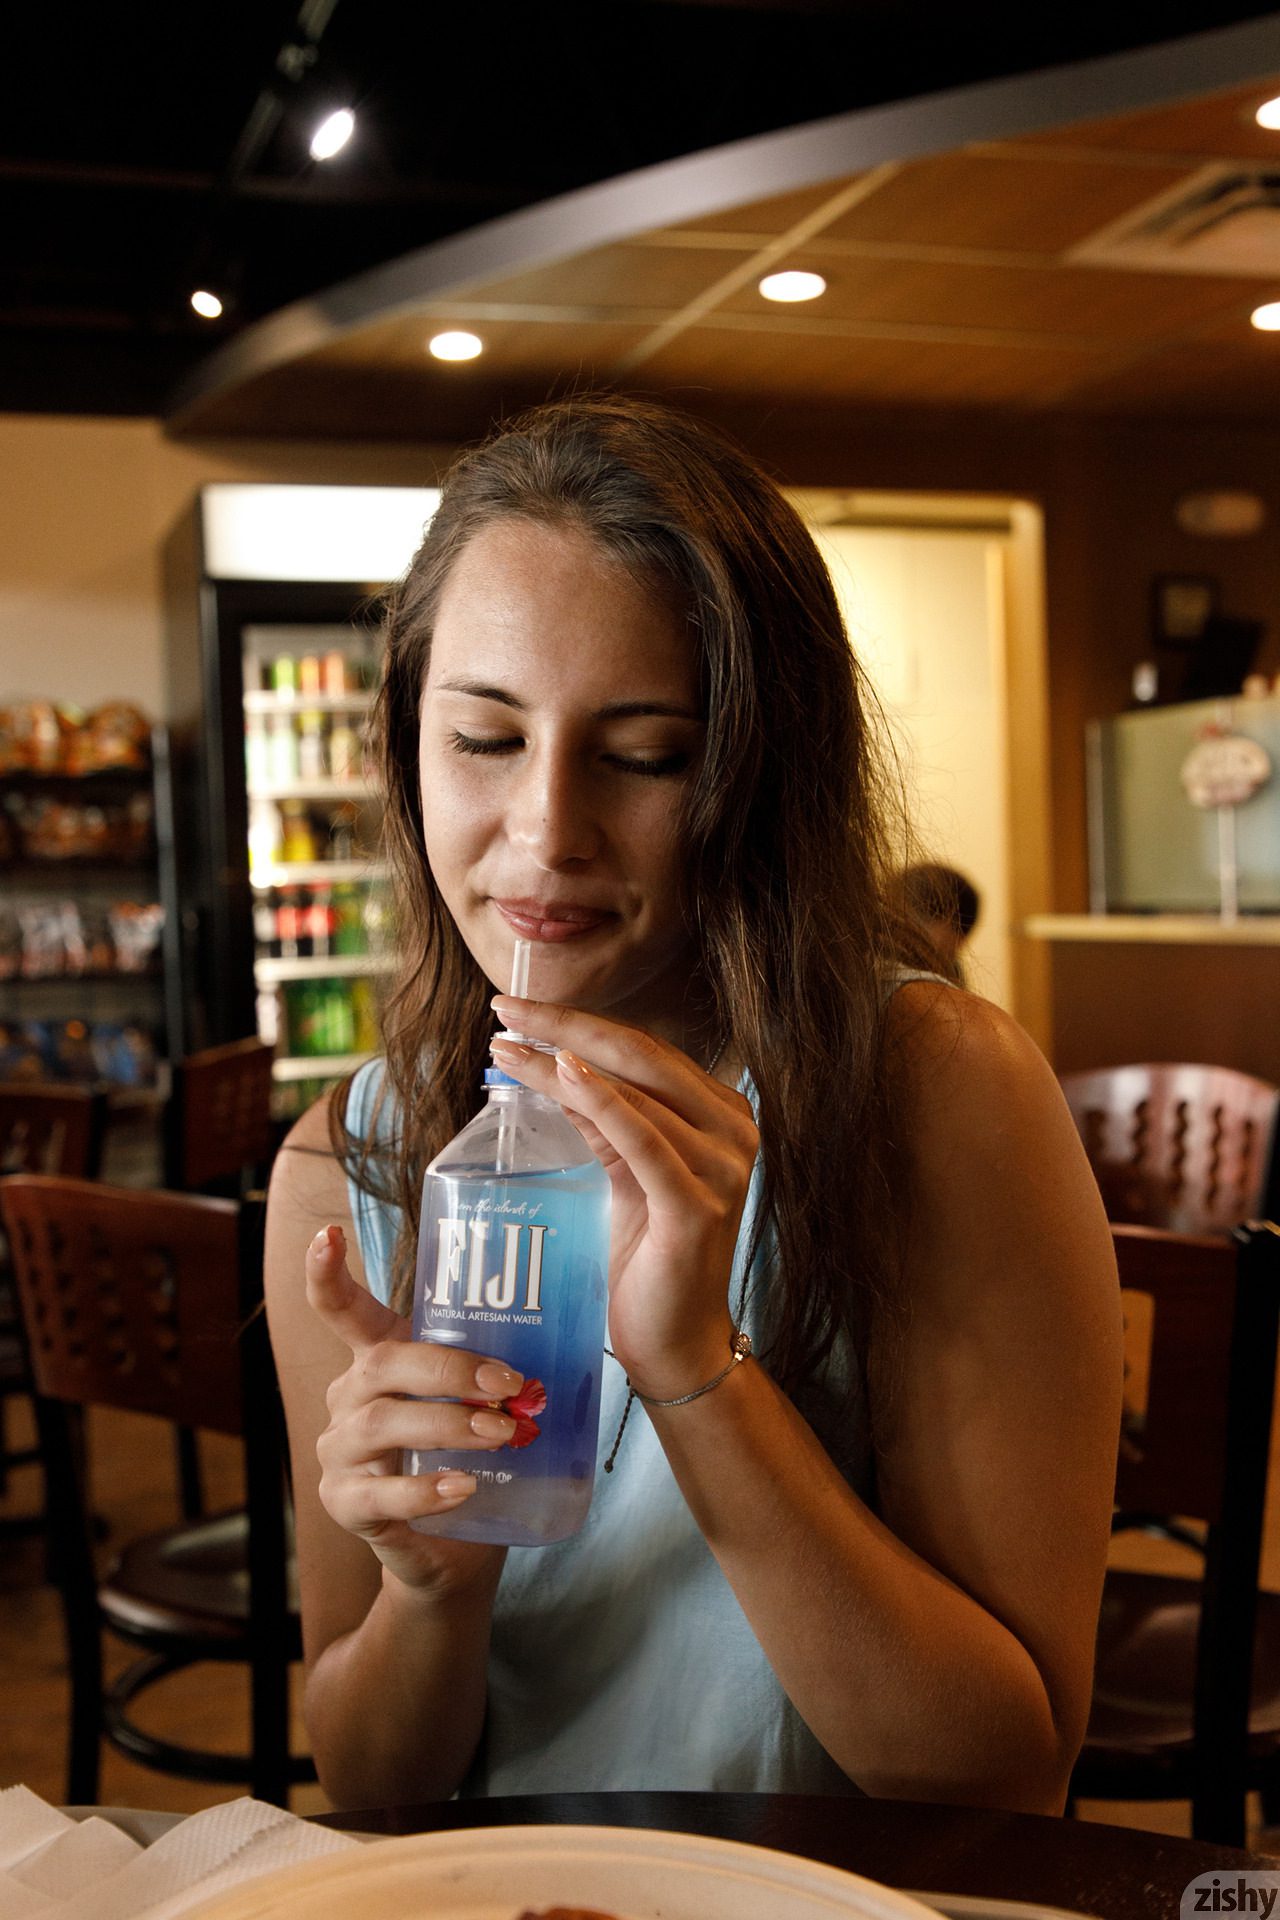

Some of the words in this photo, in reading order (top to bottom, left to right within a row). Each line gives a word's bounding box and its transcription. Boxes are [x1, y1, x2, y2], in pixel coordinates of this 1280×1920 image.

[474, 1198, 492, 1213] the
[494, 1200, 526, 1216] islands
[528, 1203, 543, 1219] of
[432, 1217, 548, 1311] FIJI
[431, 1308, 466, 1320] NATURAL
[468, 1311, 510, 1323] ARTESIAN
[513, 1315, 542, 1326] WATER
